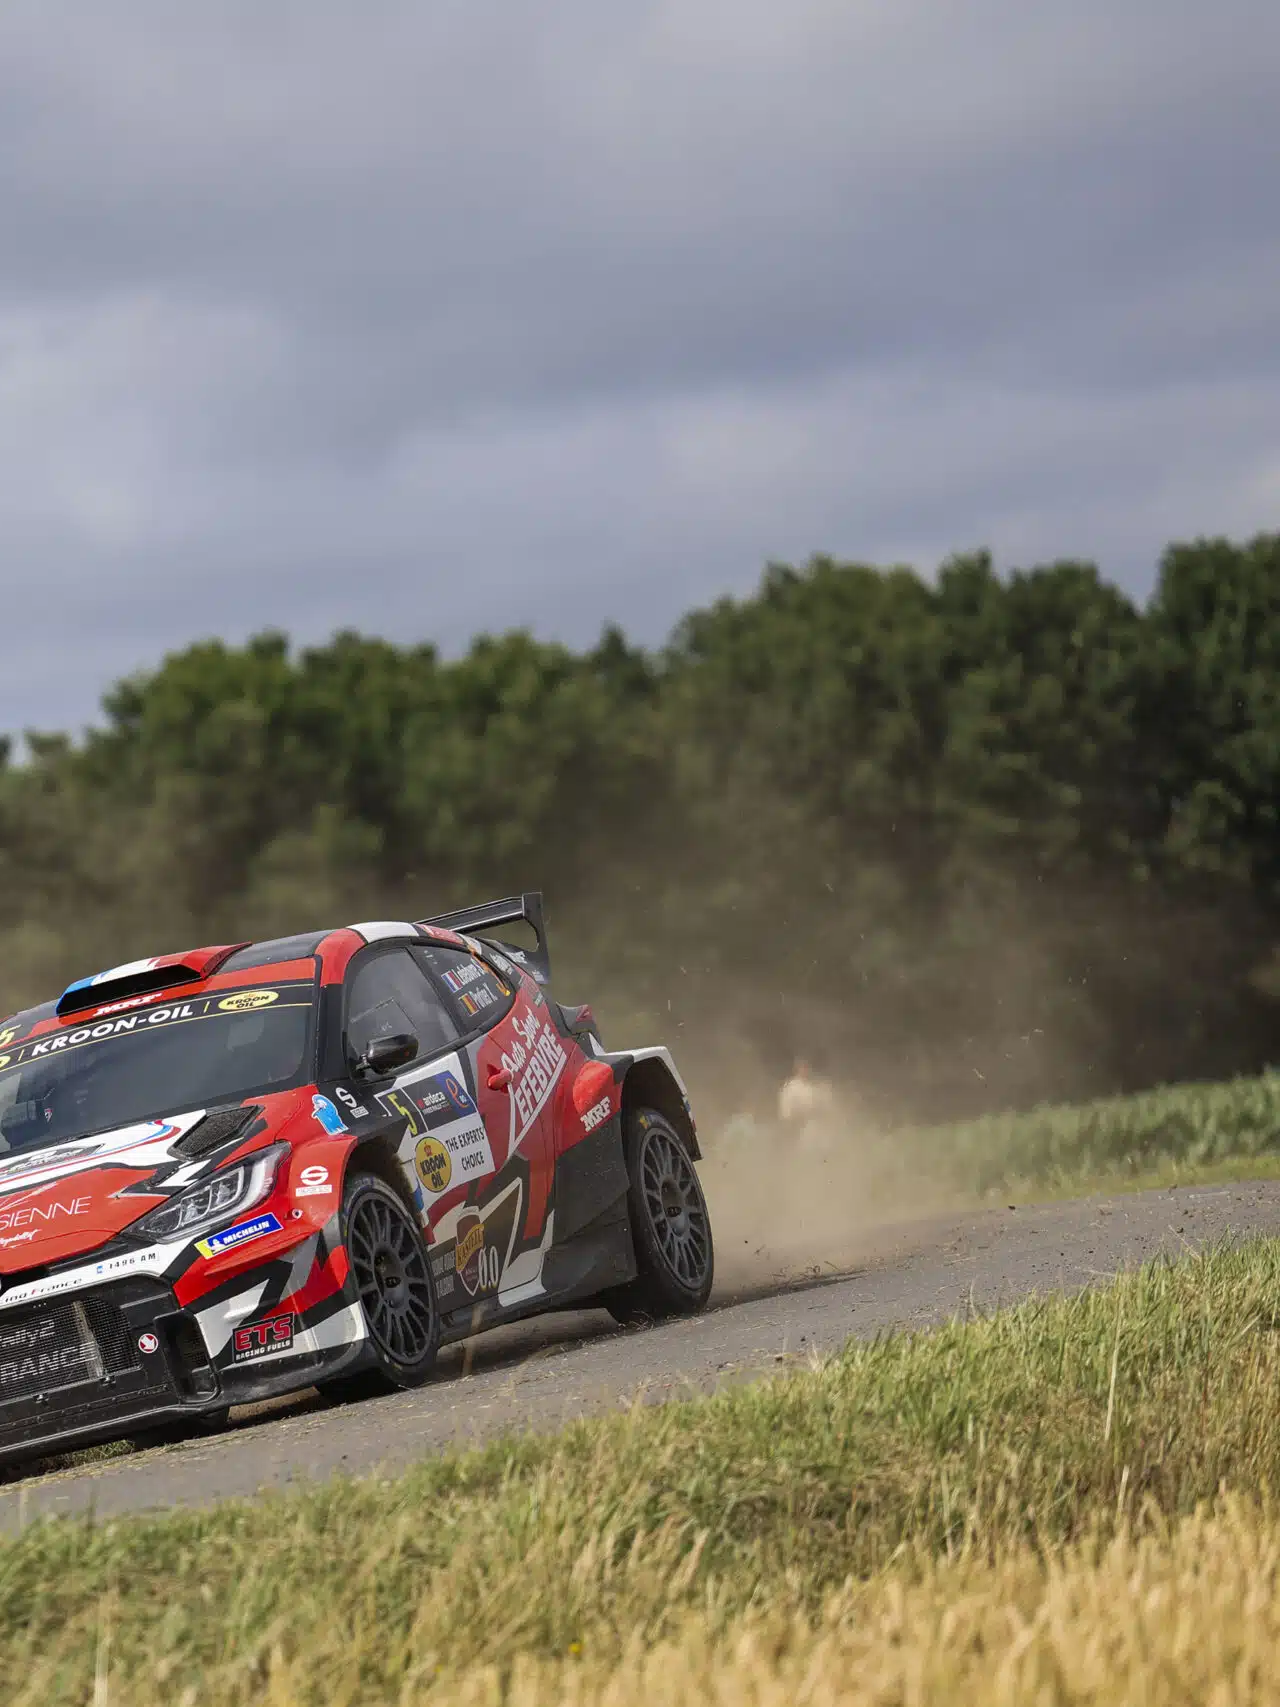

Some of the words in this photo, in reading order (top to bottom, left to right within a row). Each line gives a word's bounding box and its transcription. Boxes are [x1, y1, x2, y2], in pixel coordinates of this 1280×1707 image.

[226, 995, 270, 1006] KROON
[31, 1004, 194, 1057] KROON-OIL
[511, 1004, 541, 1050] Sport
[387, 1092, 418, 1136] 5
[580, 1096, 612, 1133] MRF
[445, 1136, 460, 1153] THE
[419, 1152, 447, 1176] KROON
[461, 1151, 485, 1171] CHOICE
[431, 1171, 445, 1189] OIL
[223, 1220, 270, 1245] MICHELIN
[140, 1253, 156, 1262] AM
[235, 1317, 291, 1351] ETS
[235, 1347, 266, 1361] RACING
[267, 1340, 291, 1352] FUELS
